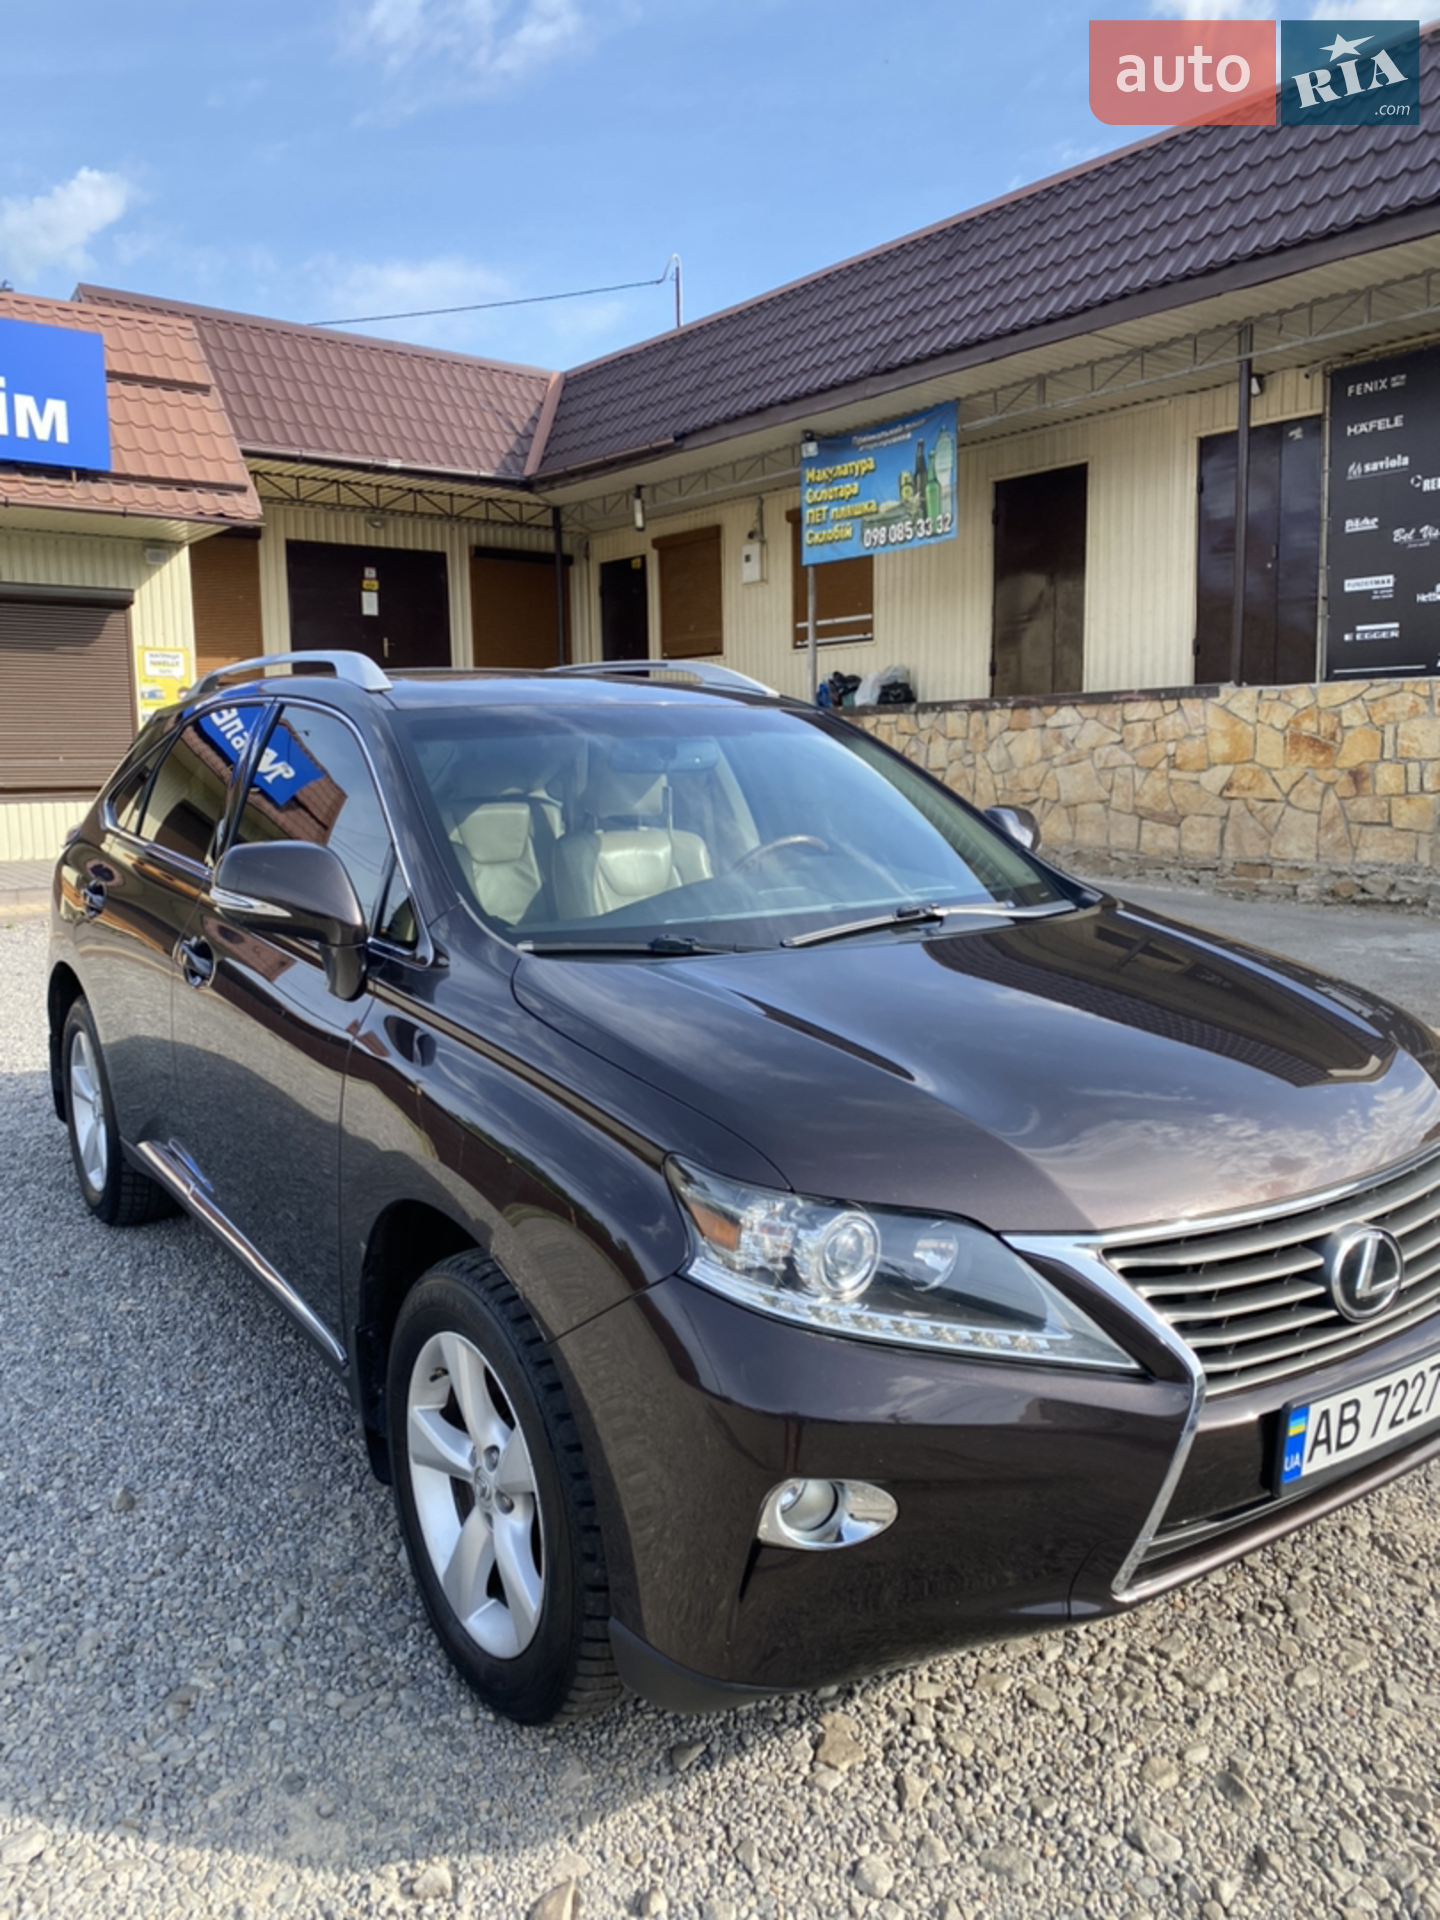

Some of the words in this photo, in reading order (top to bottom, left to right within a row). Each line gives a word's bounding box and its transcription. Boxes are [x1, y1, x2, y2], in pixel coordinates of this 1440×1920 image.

[1347, 376, 1388, 397] FENIX
[805, 456, 875, 485] Макулатура
[1364, 454, 1410, 474] saviola
[806, 505, 828, 524] ПЕТ
[863, 525, 886, 548] 098
[888, 520, 913, 543] 085
[916, 517, 932, 539] 33
[936, 513, 951, 534] 32
[1356, 628, 1400, 641] EGGER
[1307, 1397, 1361, 1464] AB
[1284, 1452, 1301, 1472] UA
